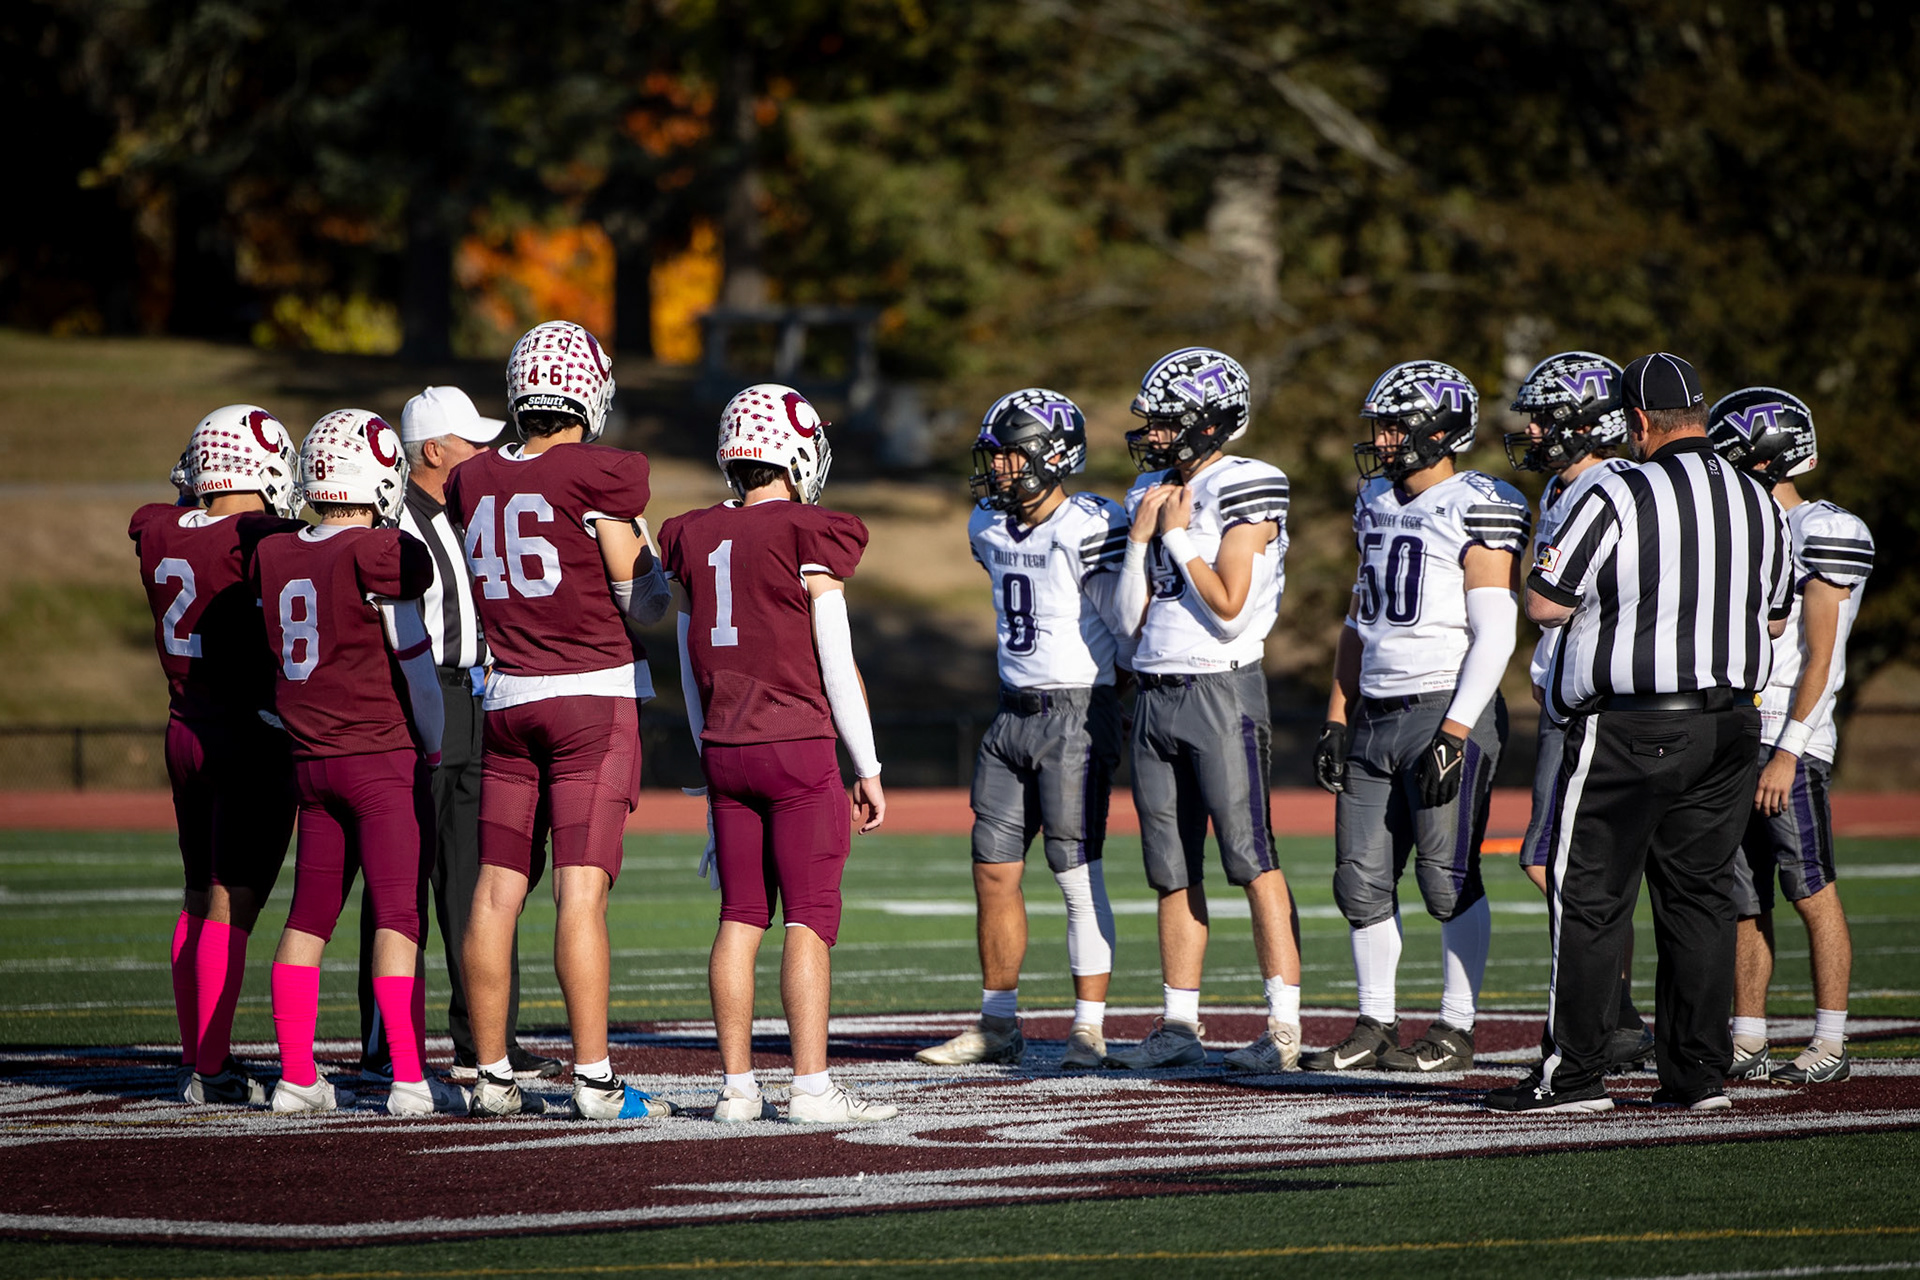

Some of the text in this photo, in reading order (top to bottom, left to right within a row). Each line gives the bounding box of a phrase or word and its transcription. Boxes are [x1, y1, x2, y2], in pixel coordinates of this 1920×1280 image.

[528, 394, 565, 407] schutt
[1172, 362, 1229, 407] VT
[1413, 380, 1470, 413] VT
[1555, 367, 1613, 403] VT
[1024, 401, 1075, 431] VT
[1723, 402, 1784, 440] VT
[200, 449, 212, 471] 2
[315, 459, 326, 481] 8
[720, 446, 762, 460] Riddell
[194, 478, 233, 493] Riddell
[305, 489, 348, 501] Riddell
[464, 493, 562, 600] 46
[708, 539, 738, 647] 1
[1359, 533, 1428, 627] 50
[155, 557, 203, 658] 2
[1003, 572, 1037, 657] 8
[279, 578, 320, 681] 8
